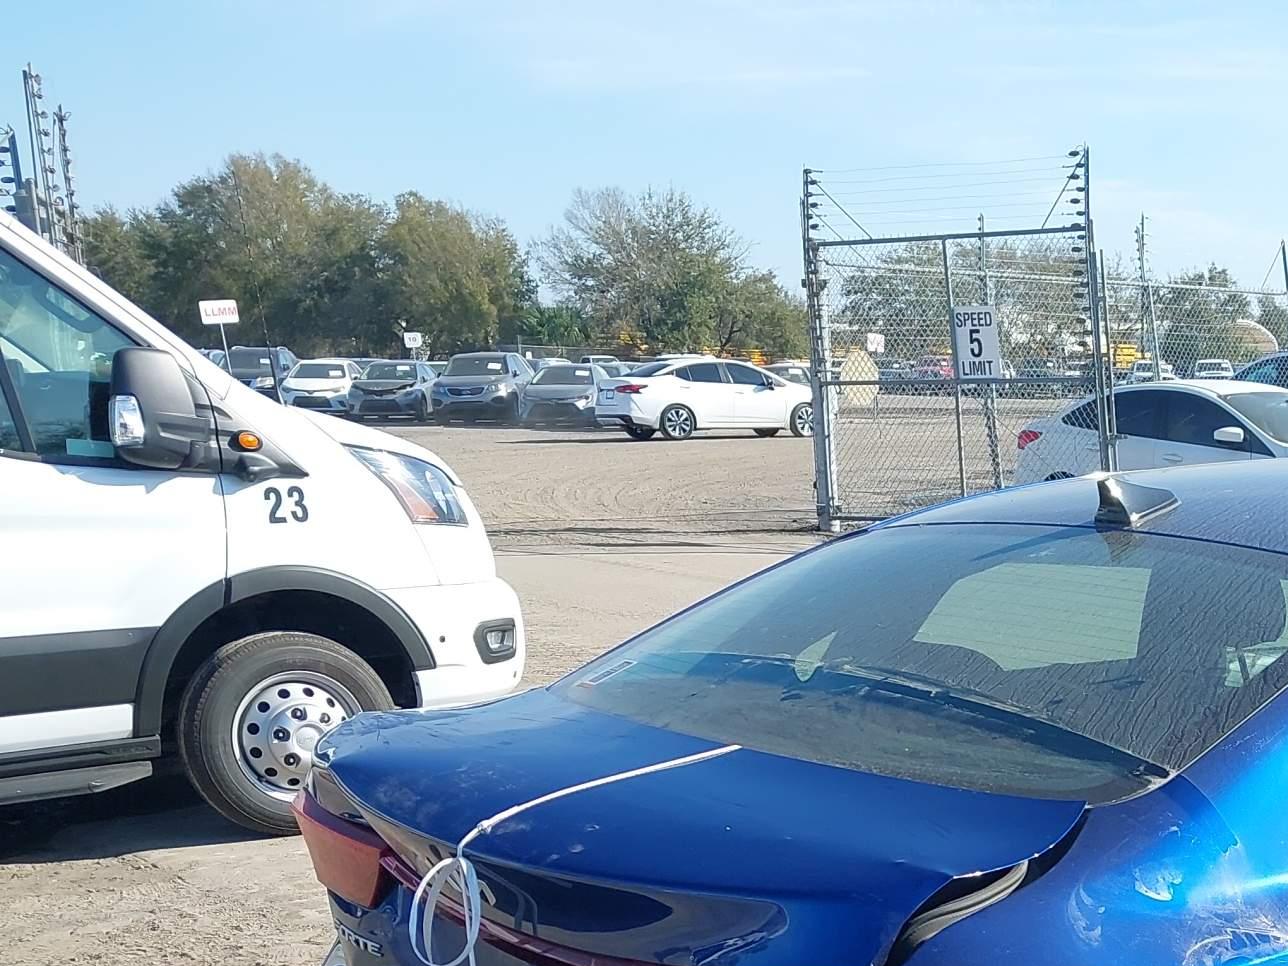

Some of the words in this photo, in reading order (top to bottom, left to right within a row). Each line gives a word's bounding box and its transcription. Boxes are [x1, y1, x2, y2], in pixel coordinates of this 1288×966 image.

[955, 311, 992, 328] SPEED
[968, 328, 983, 357] 5
[962, 360, 994, 376] LIMIT
[263, 485, 309, 524] 23
